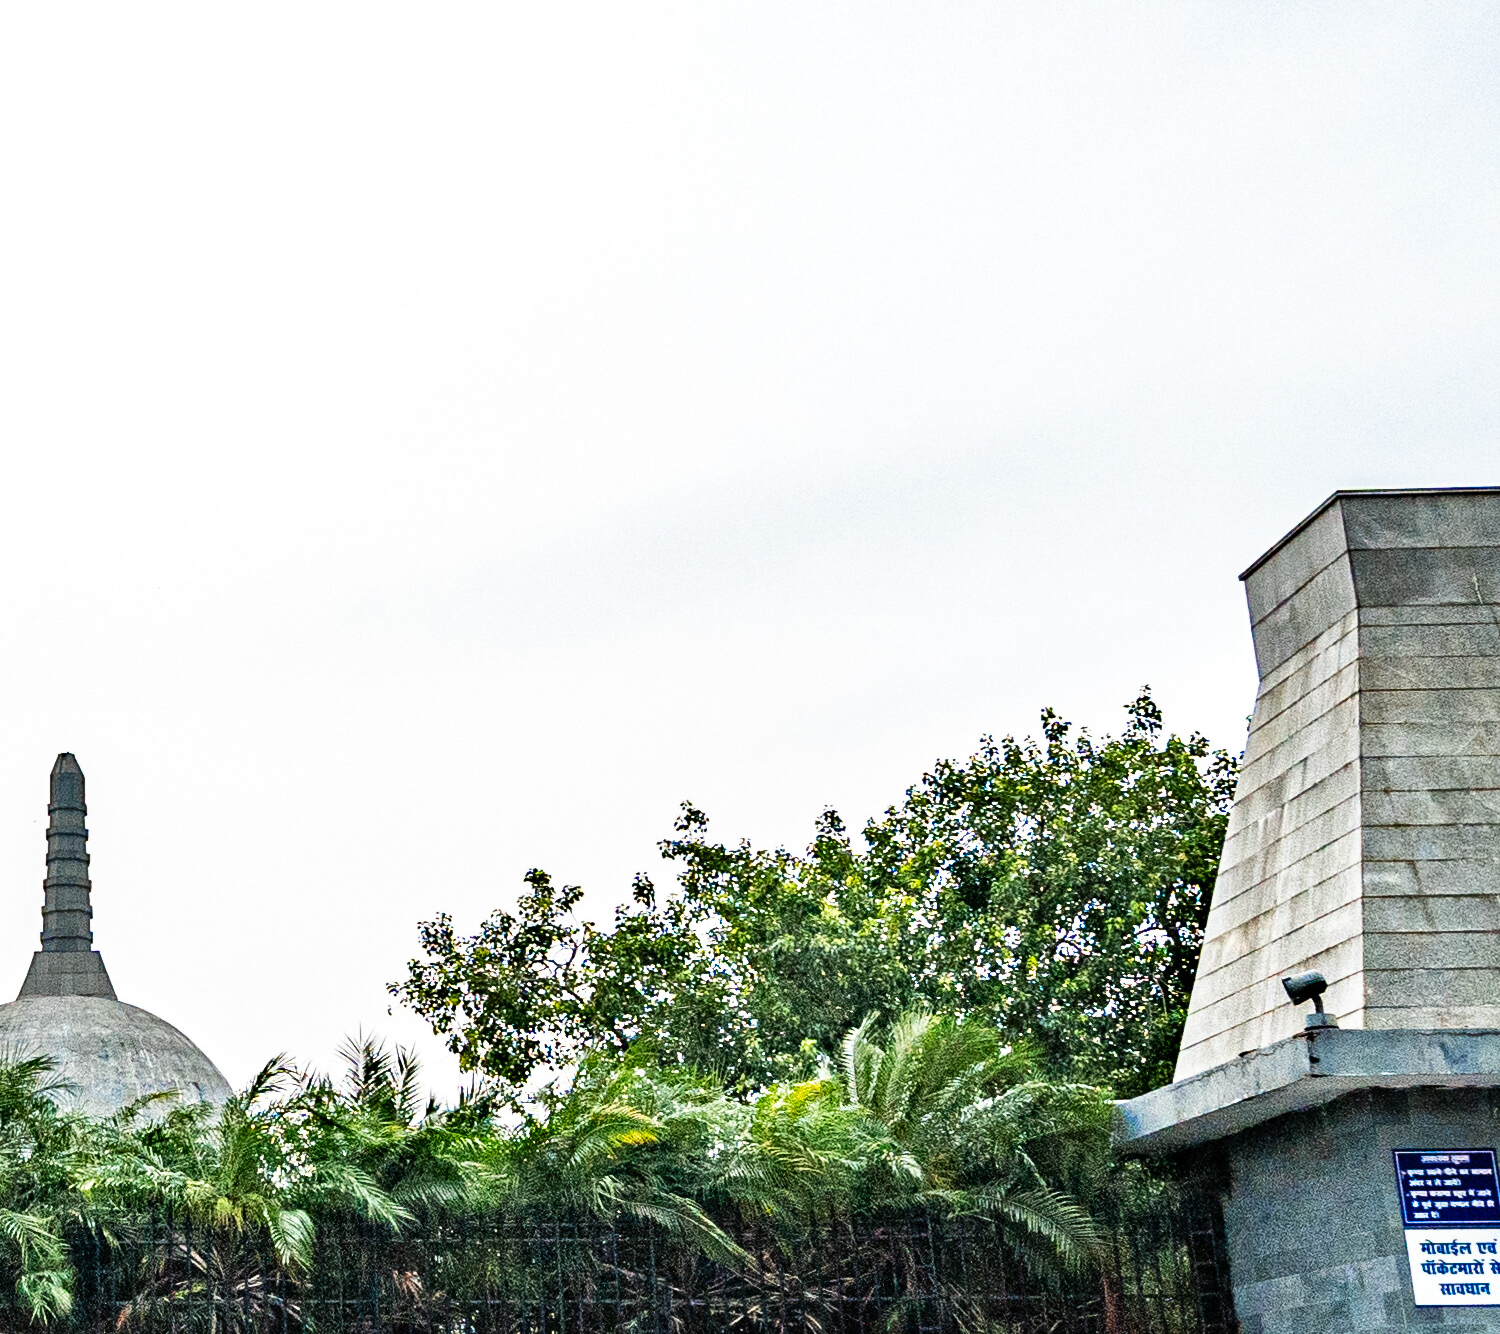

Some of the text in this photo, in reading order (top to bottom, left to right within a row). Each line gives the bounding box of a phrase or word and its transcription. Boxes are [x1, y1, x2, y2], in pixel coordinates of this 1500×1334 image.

[1419, 1238, 1497, 1256] मोबाईल एवं
[1420, 1259, 1485, 1275] पॉकेटमारों
[1438, 1283, 1491, 1295] सावधान
